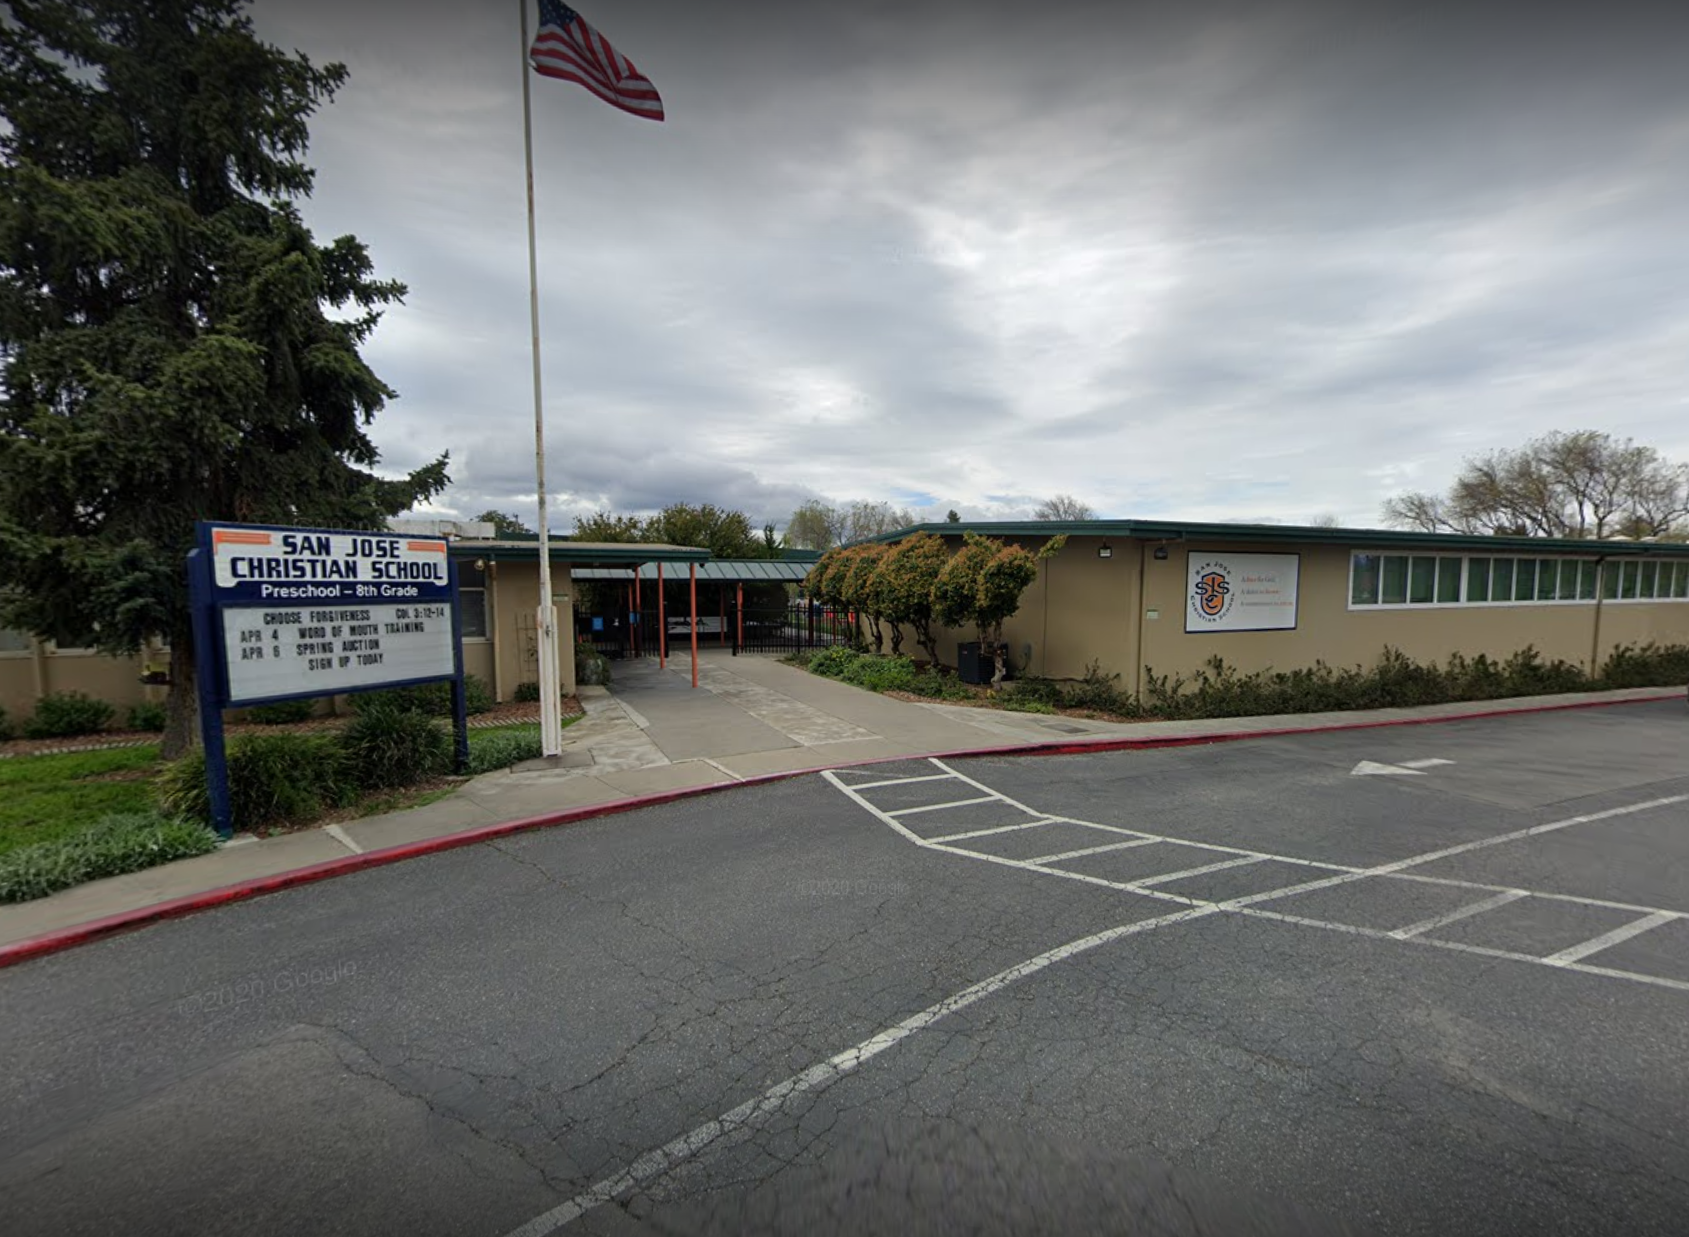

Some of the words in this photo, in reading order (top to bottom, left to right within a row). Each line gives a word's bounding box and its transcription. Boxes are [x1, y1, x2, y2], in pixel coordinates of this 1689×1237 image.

[283, 534, 331, 556] SAN
[346, 538, 400, 558] JOSE
[231, 556, 358, 579] CHRISTIAN
[371, 560, 444, 580] SCHOOL
[261, 584, 340, 598] Preschool
[356, 584, 378, 597] 8th
[380, 584, 418, 597] Grade
[263, 612, 302, 625] CHOOSE
[310, 610, 371, 623] FORGIVENESS
[414, 607, 445, 618] 3:12-14
[240, 630, 261, 643] APR
[272, 629, 279, 641] 4
[298, 626, 326, 639] WORD
[332, 626, 343, 638] OF
[350, 624, 379, 637] MOUTH
[385, 622, 425, 634] TRAINING
[241, 646, 263, 660] APR
[273, 645, 280, 657] 6
[296, 641, 334, 656] SPRING
[342, 638, 380, 652] AUCTION
[308, 656, 333, 671] SIGN
[339, 655, 351, 668] UP
[357, 653, 384, 666] TODAY
